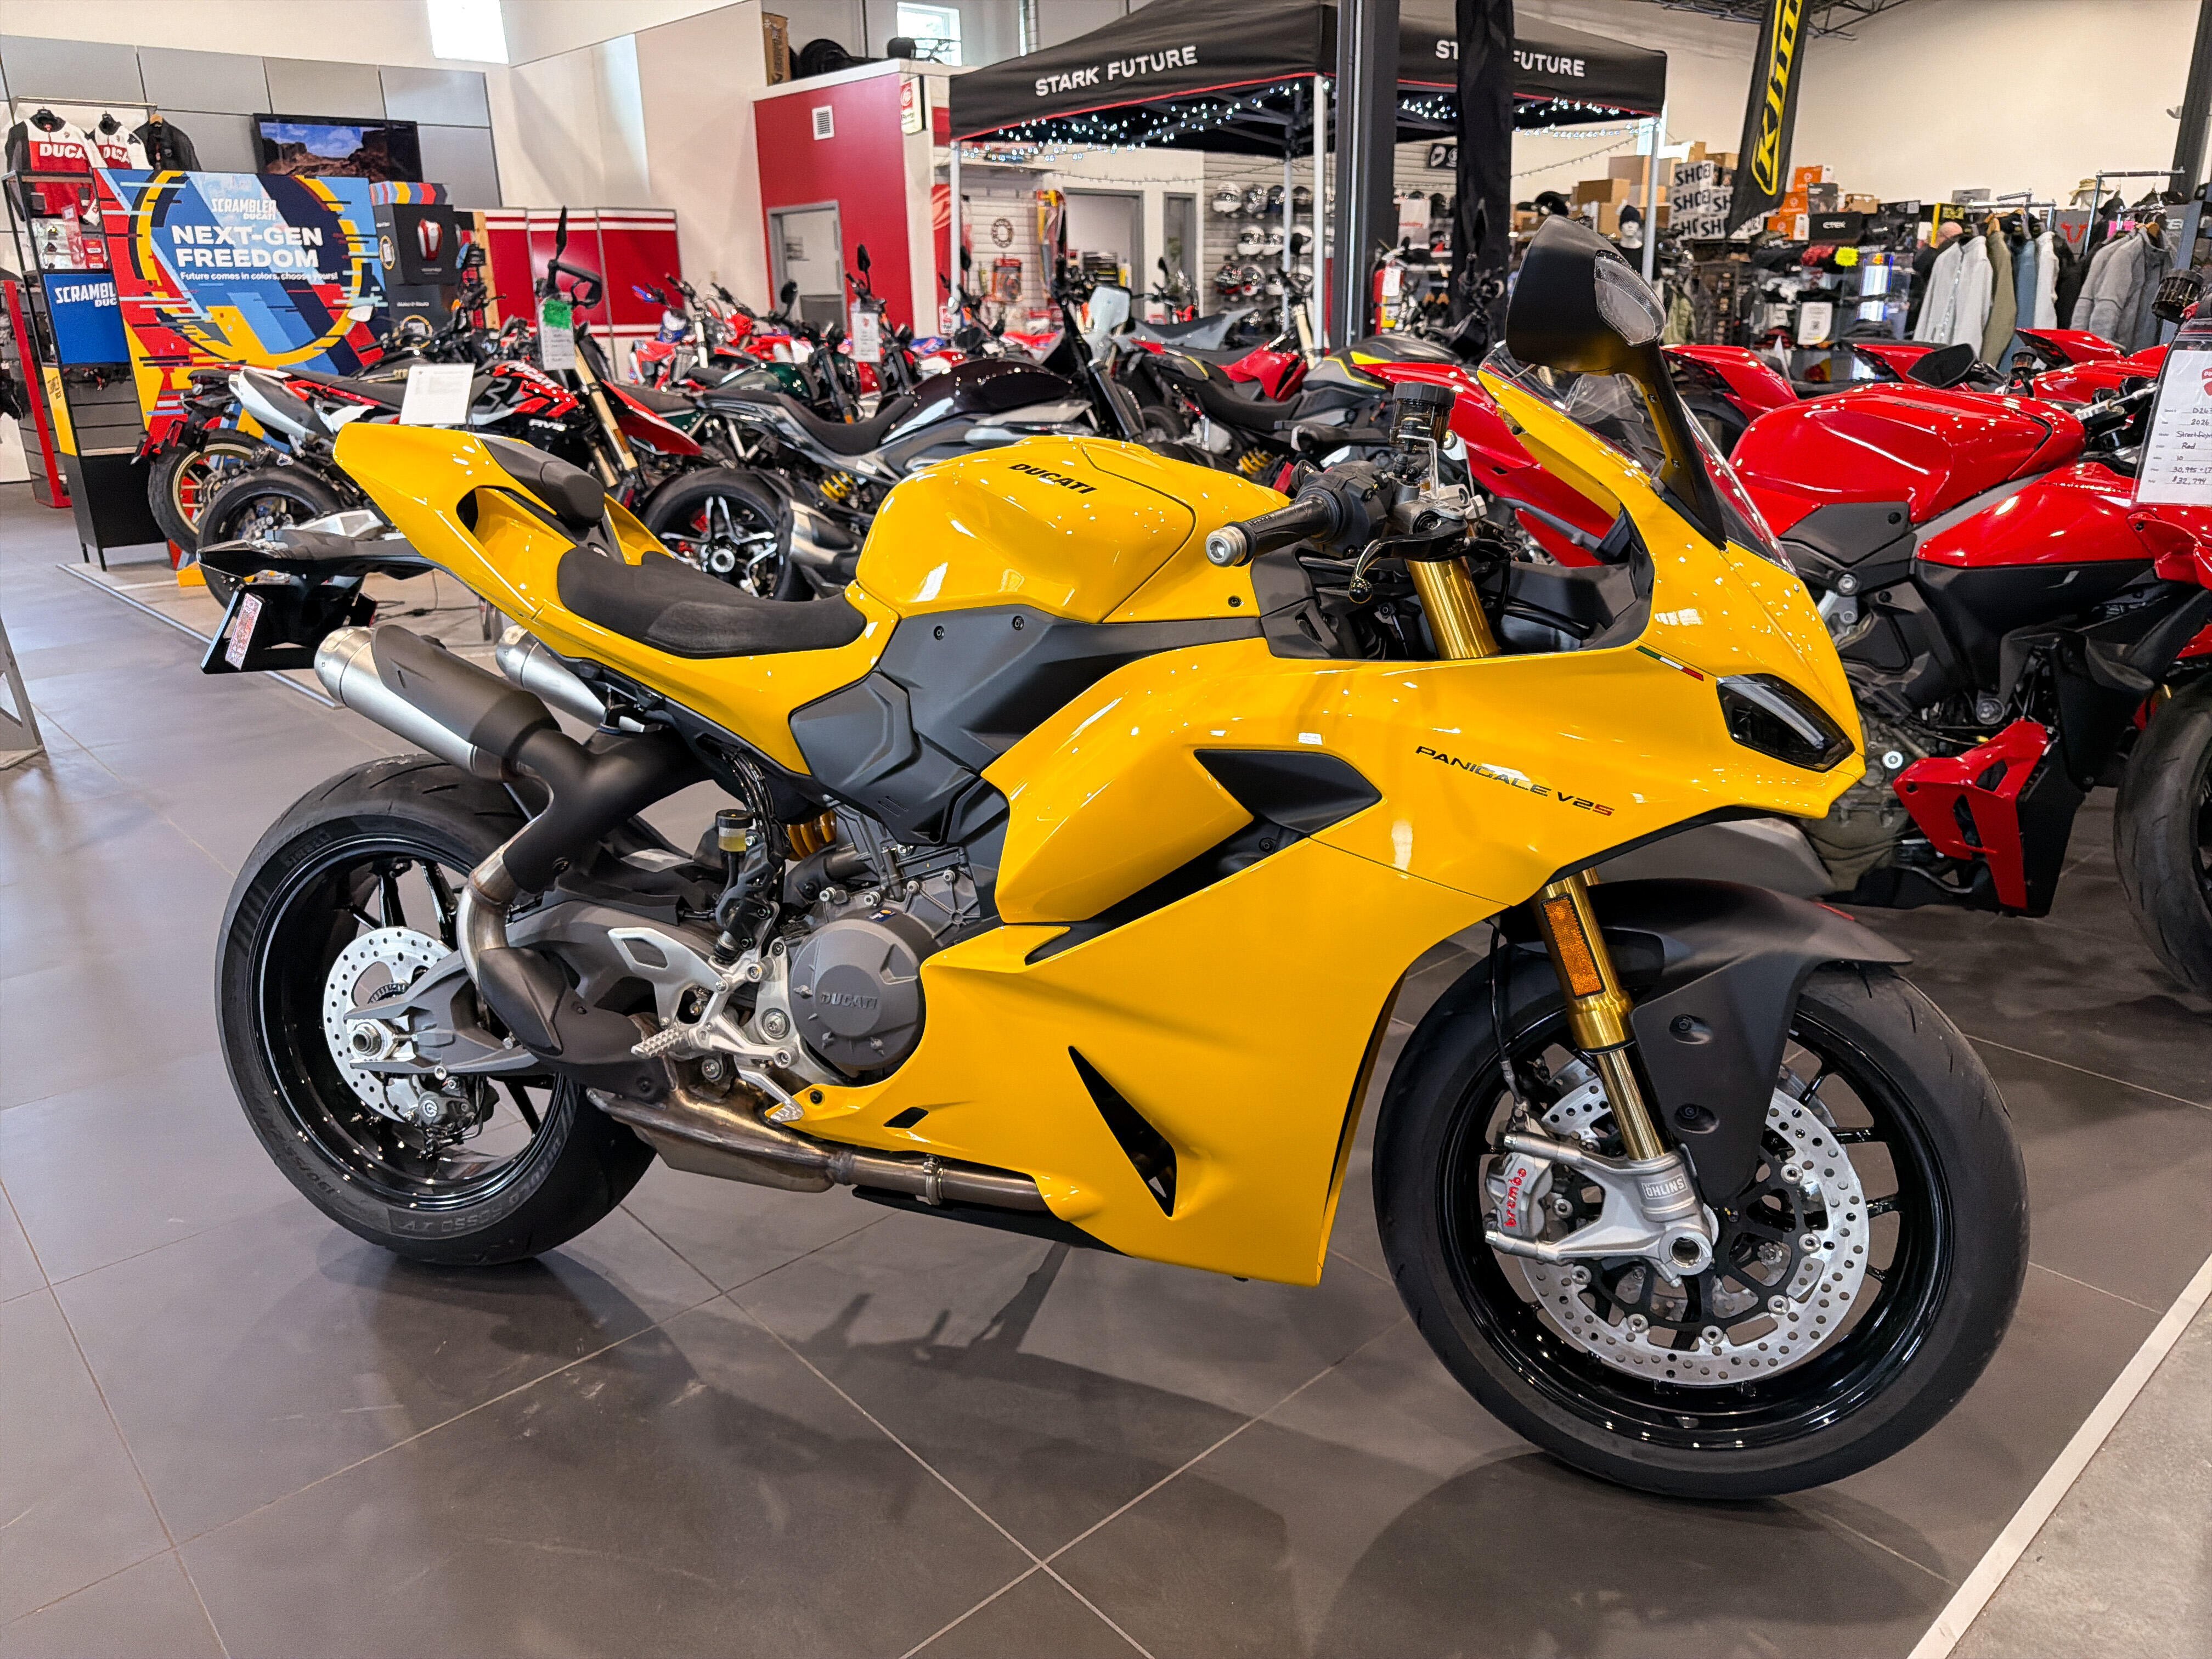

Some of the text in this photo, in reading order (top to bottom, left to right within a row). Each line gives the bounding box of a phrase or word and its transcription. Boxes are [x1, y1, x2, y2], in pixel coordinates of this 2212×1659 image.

[1035, 45, 1198, 97] STARK FUTURE
[39, 143, 87, 160] DUCA
[211, 198, 276, 213] SCRAMBLER
[242, 212, 276, 221] DUCATI
[171, 225, 324, 246] NEXT-GEN
[176, 248, 319, 268] FREEDOM
[180, 272, 210, 280] Future
[241, 272, 250, 280] in
[251, 272, 280, 281] colors,
[54, 282, 117, 304] SCRAMBL
[94, 297, 117, 308] DUC
[1007, 464, 1098, 494] DUCATI
[1415, 746, 1615, 816] PANIGALE V2S
[820, 992, 878, 1010] DUCATI
[1504, 1167, 1527, 1227] brembo
[1644, 1178, 1684, 1197] ÖHLINS
